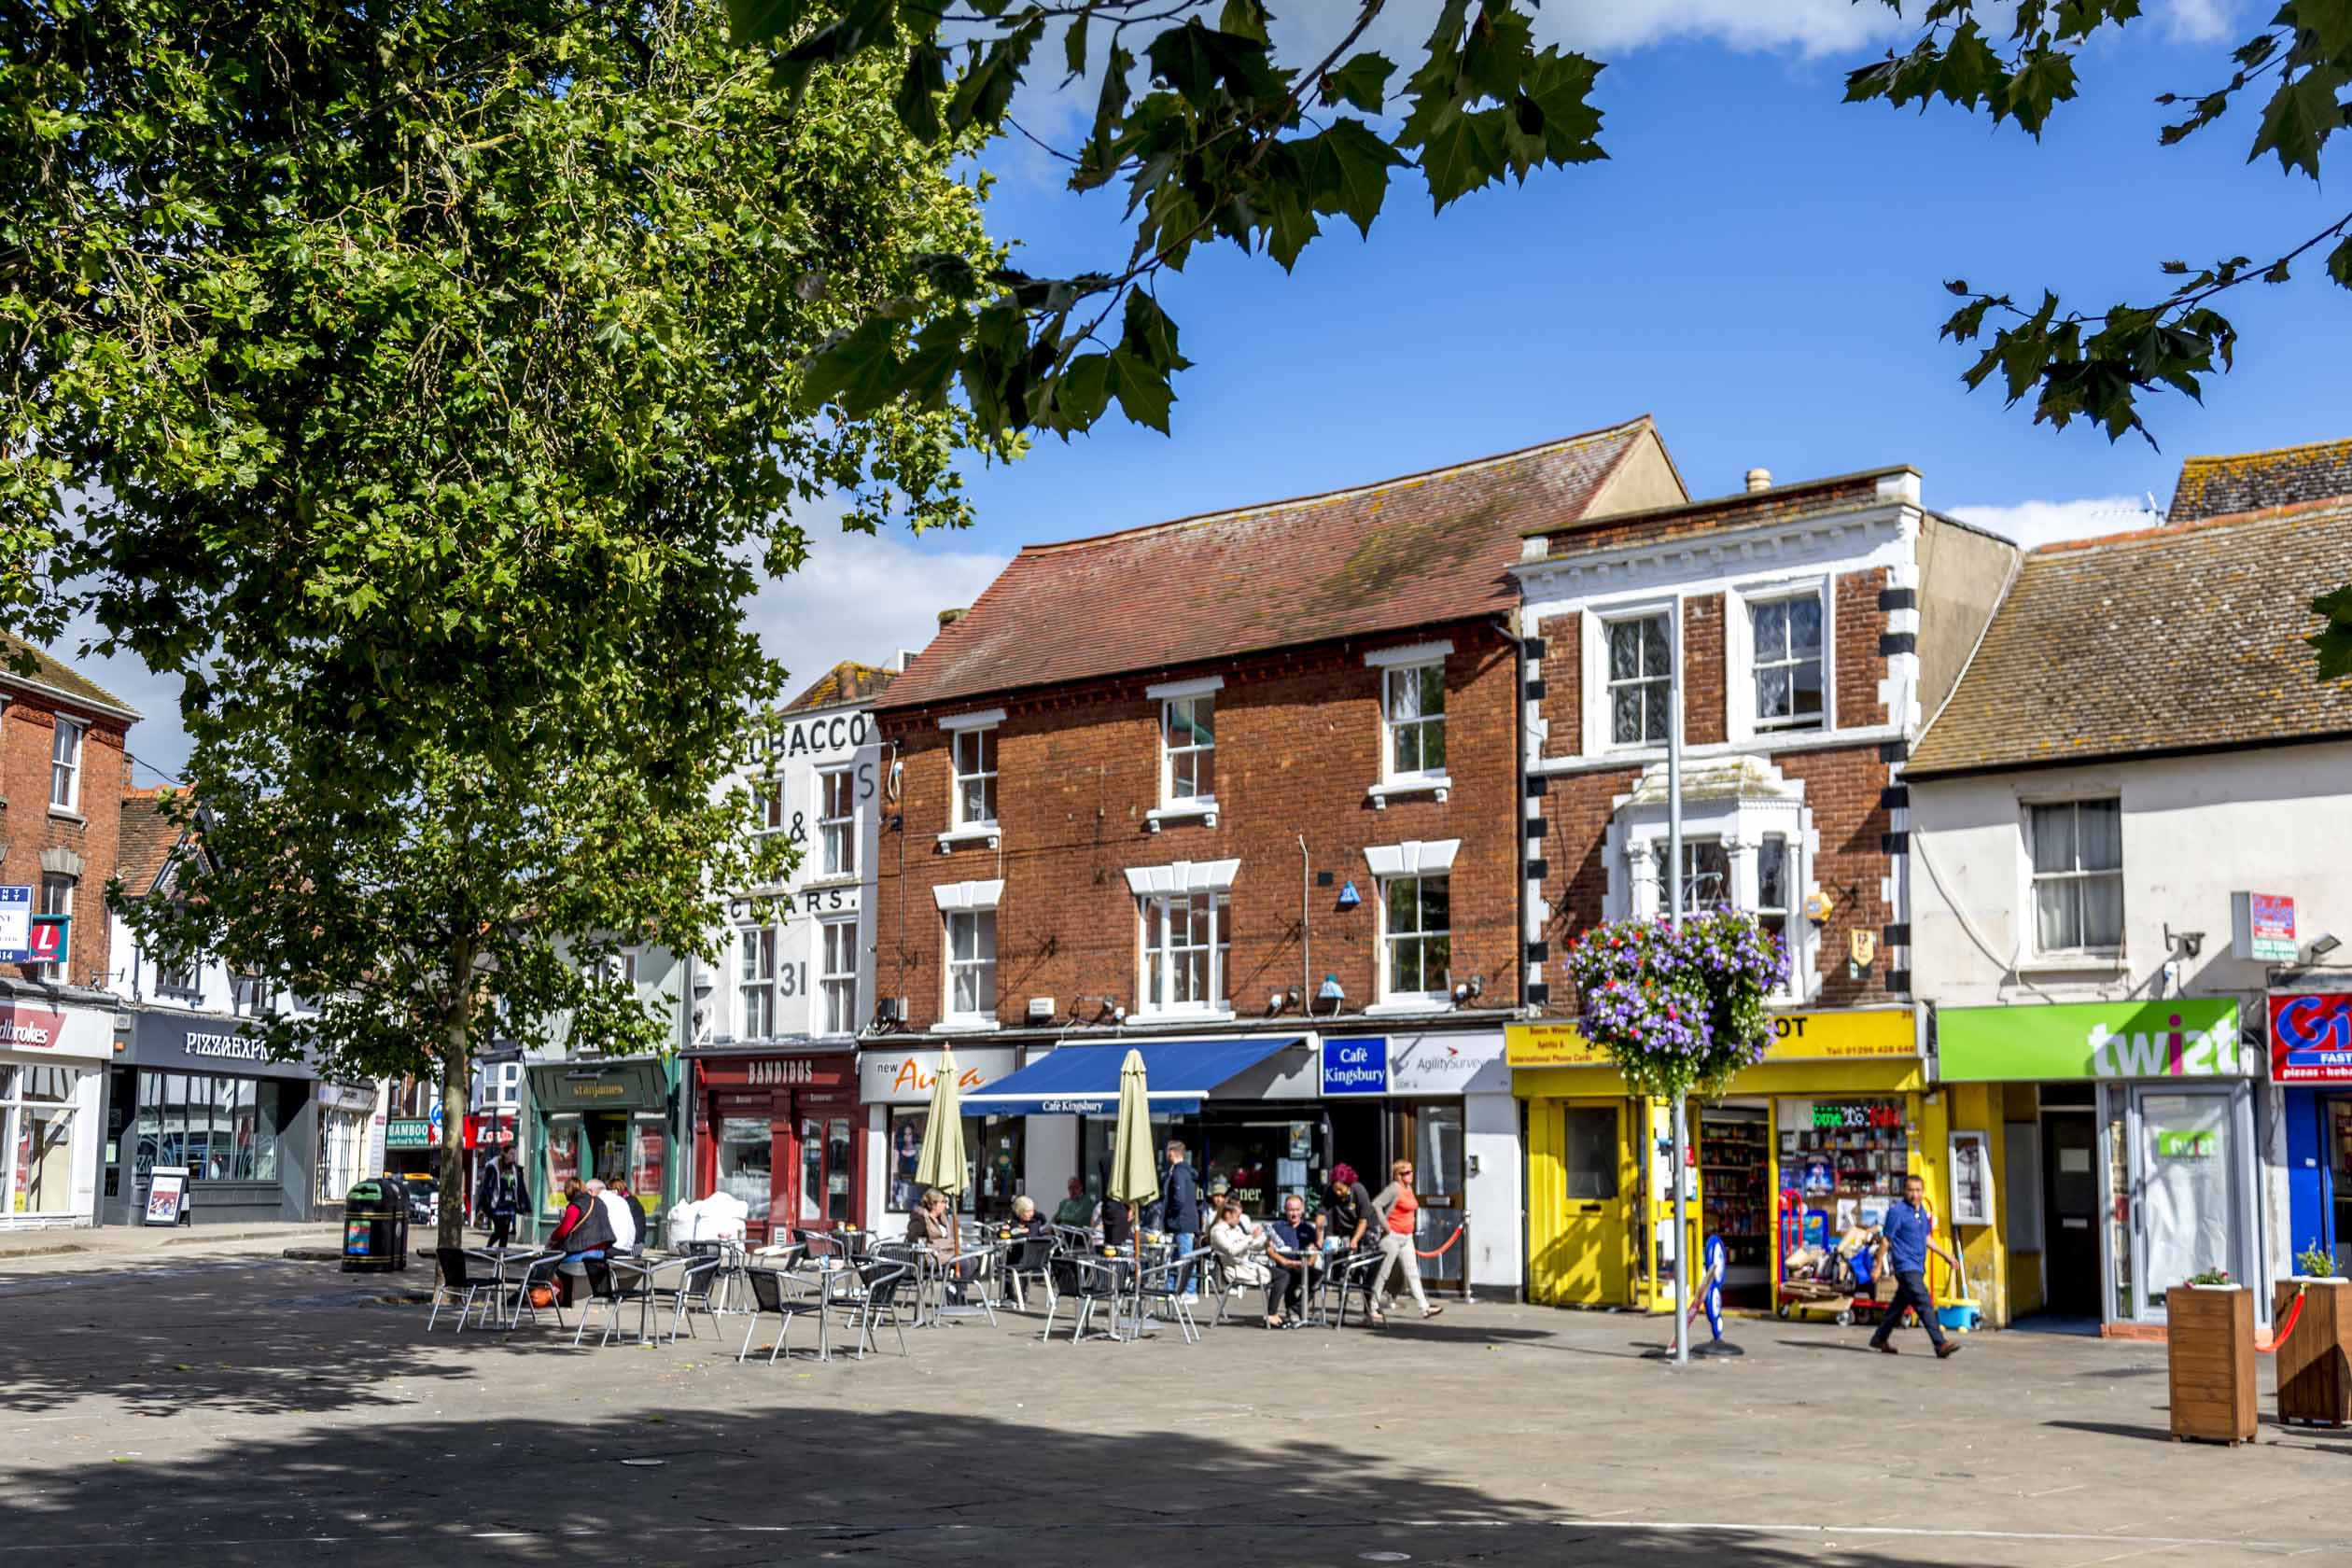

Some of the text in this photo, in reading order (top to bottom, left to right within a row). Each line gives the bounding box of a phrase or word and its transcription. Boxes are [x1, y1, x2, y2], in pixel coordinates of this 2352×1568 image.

[733, 714, 866, 764] OBACCO
[37, 925, 53, 949] L
[780, 961, 806, 997] 31
[186, 1031, 298, 1063] PIZZAEXPR
[1339, 1046, 1369, 1063] Café
[748, 1060, 813, 1085] BANDIDOS
[877, 1057, 986, 1094] new Aua
[1324, 1067, 1385, 1085] Kingsbury
[1062, 1099, 1104, 1113] Kingsbury
[388, 1124, 428, 1136] BAMBOO
